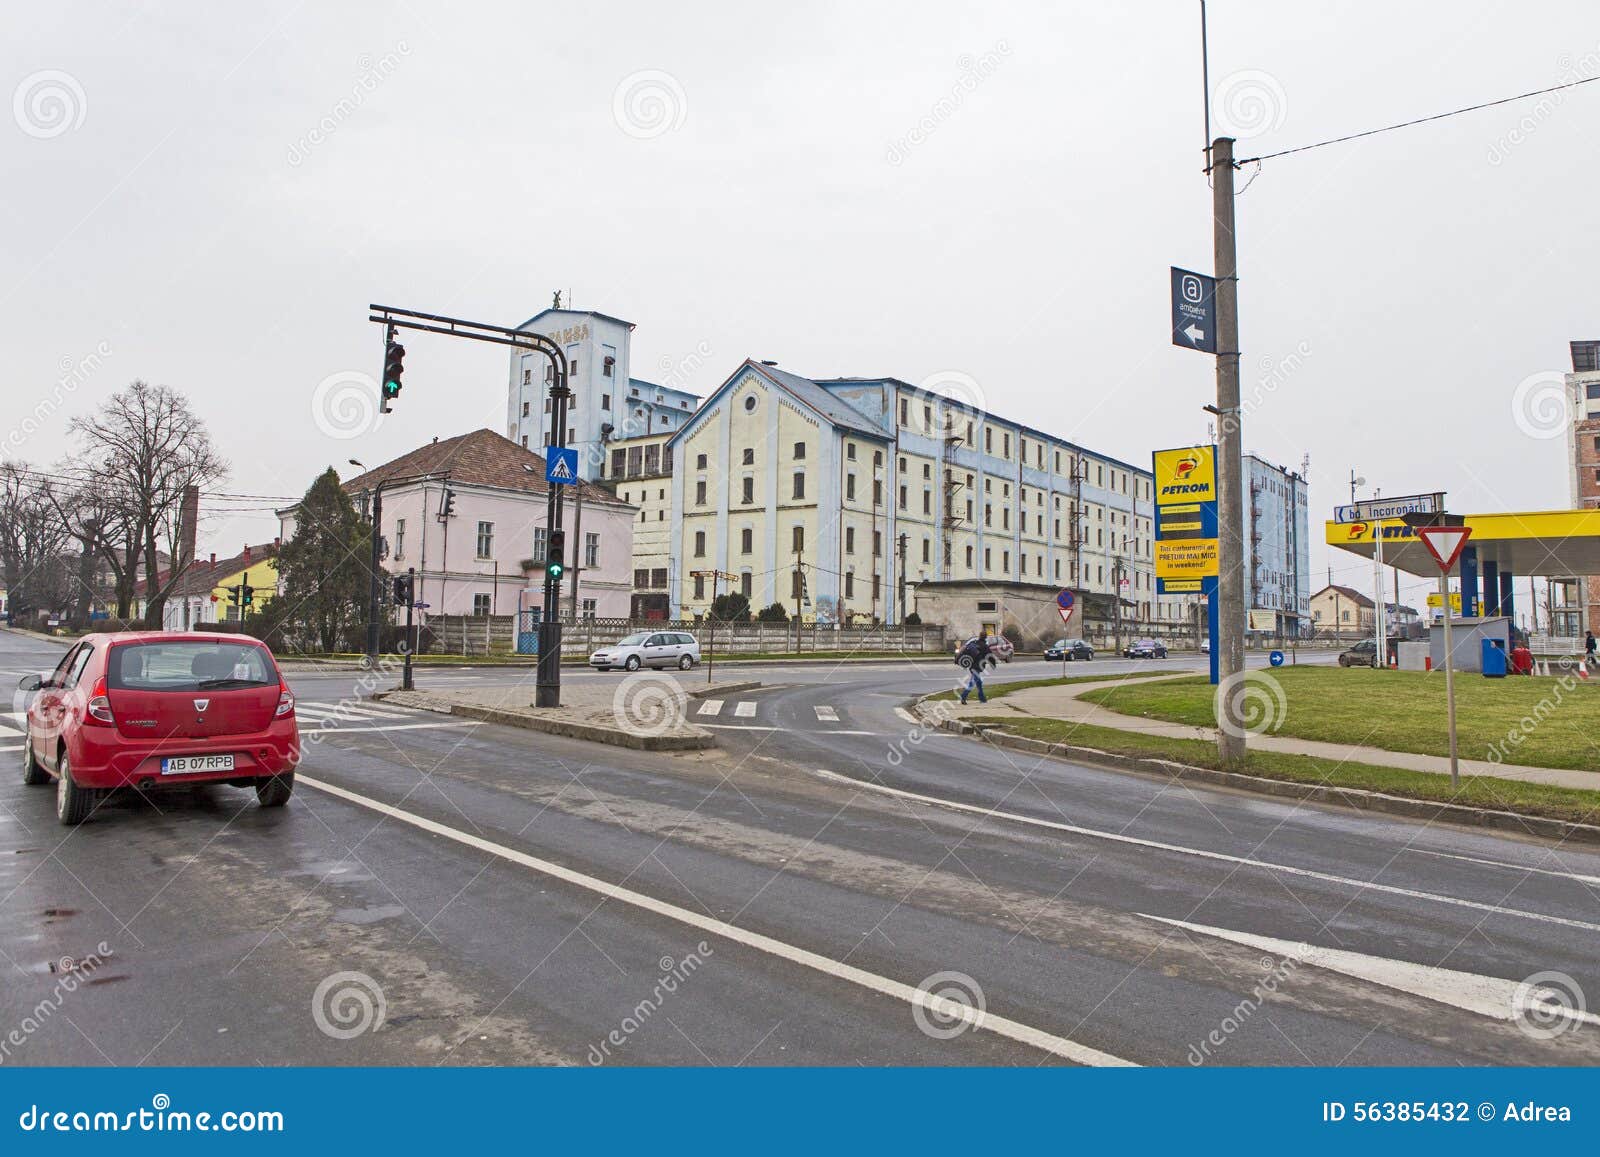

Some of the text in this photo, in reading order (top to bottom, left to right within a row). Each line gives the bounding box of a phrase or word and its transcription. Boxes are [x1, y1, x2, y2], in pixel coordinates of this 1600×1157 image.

[1162, 483, 1209, 495] PETROM
[1200, 552, 1217, 560] MICI
[169, 757, 233, 771] AB 07 RPB
